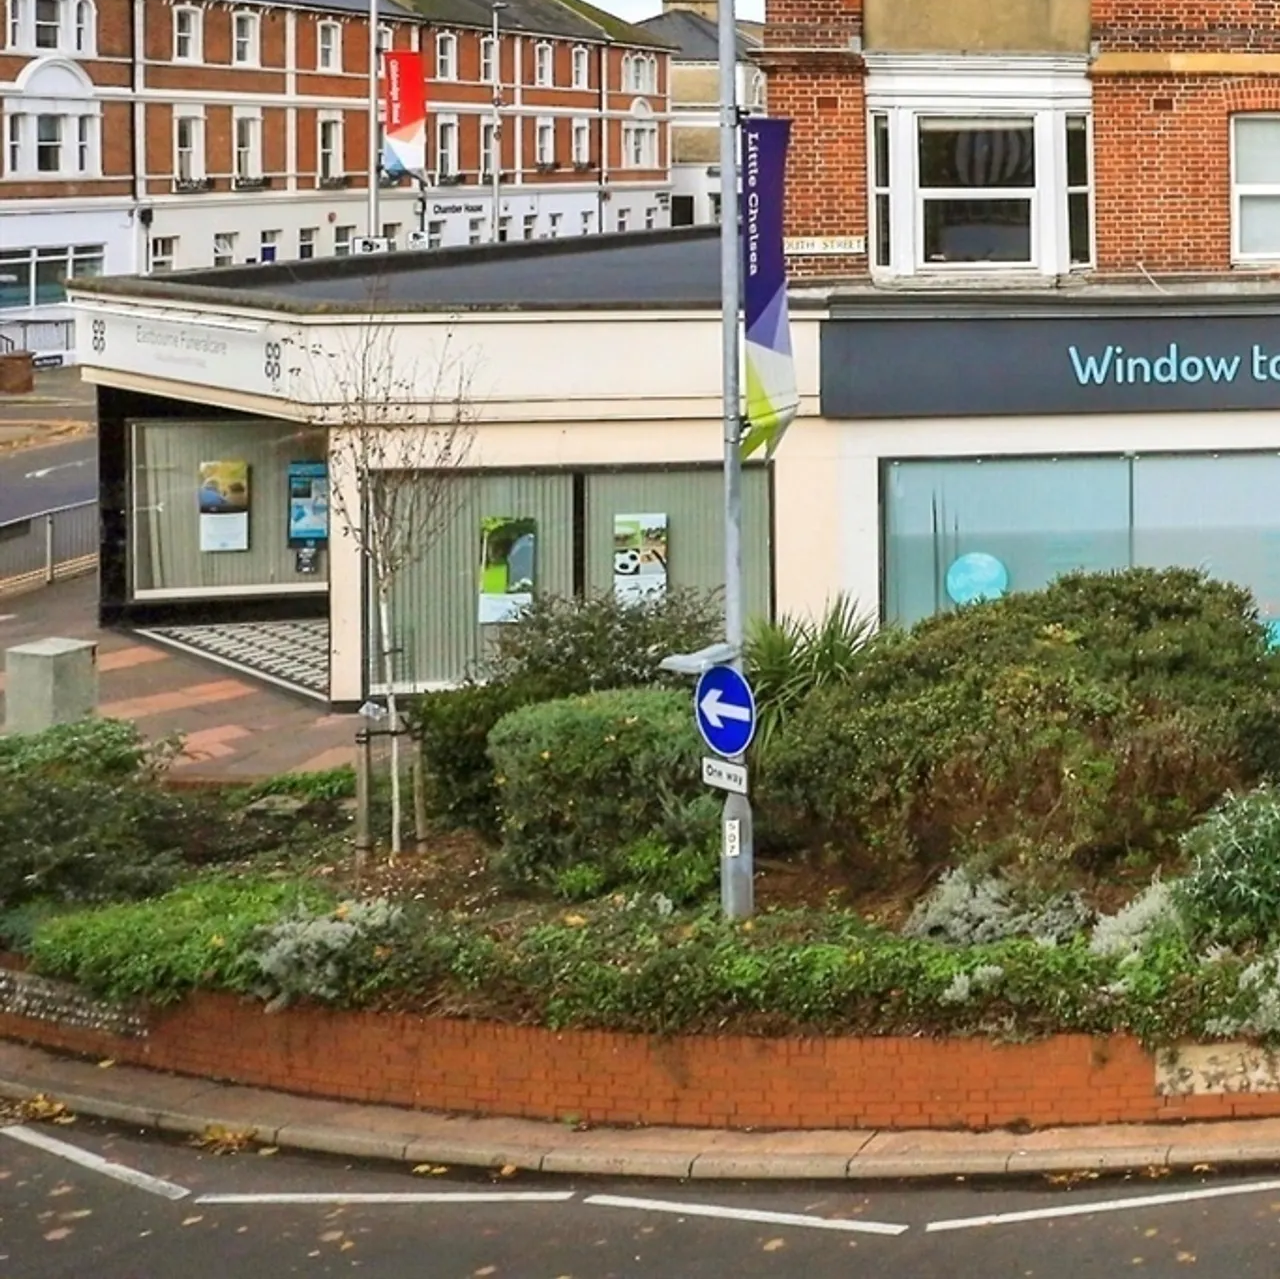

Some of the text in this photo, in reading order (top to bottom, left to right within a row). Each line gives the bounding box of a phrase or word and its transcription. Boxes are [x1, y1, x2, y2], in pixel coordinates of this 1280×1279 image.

[748, 132, 759, 276] Little Chelsea
[1068, 342, 1241, 385] Window
[706, 764, 742, 786] One way
